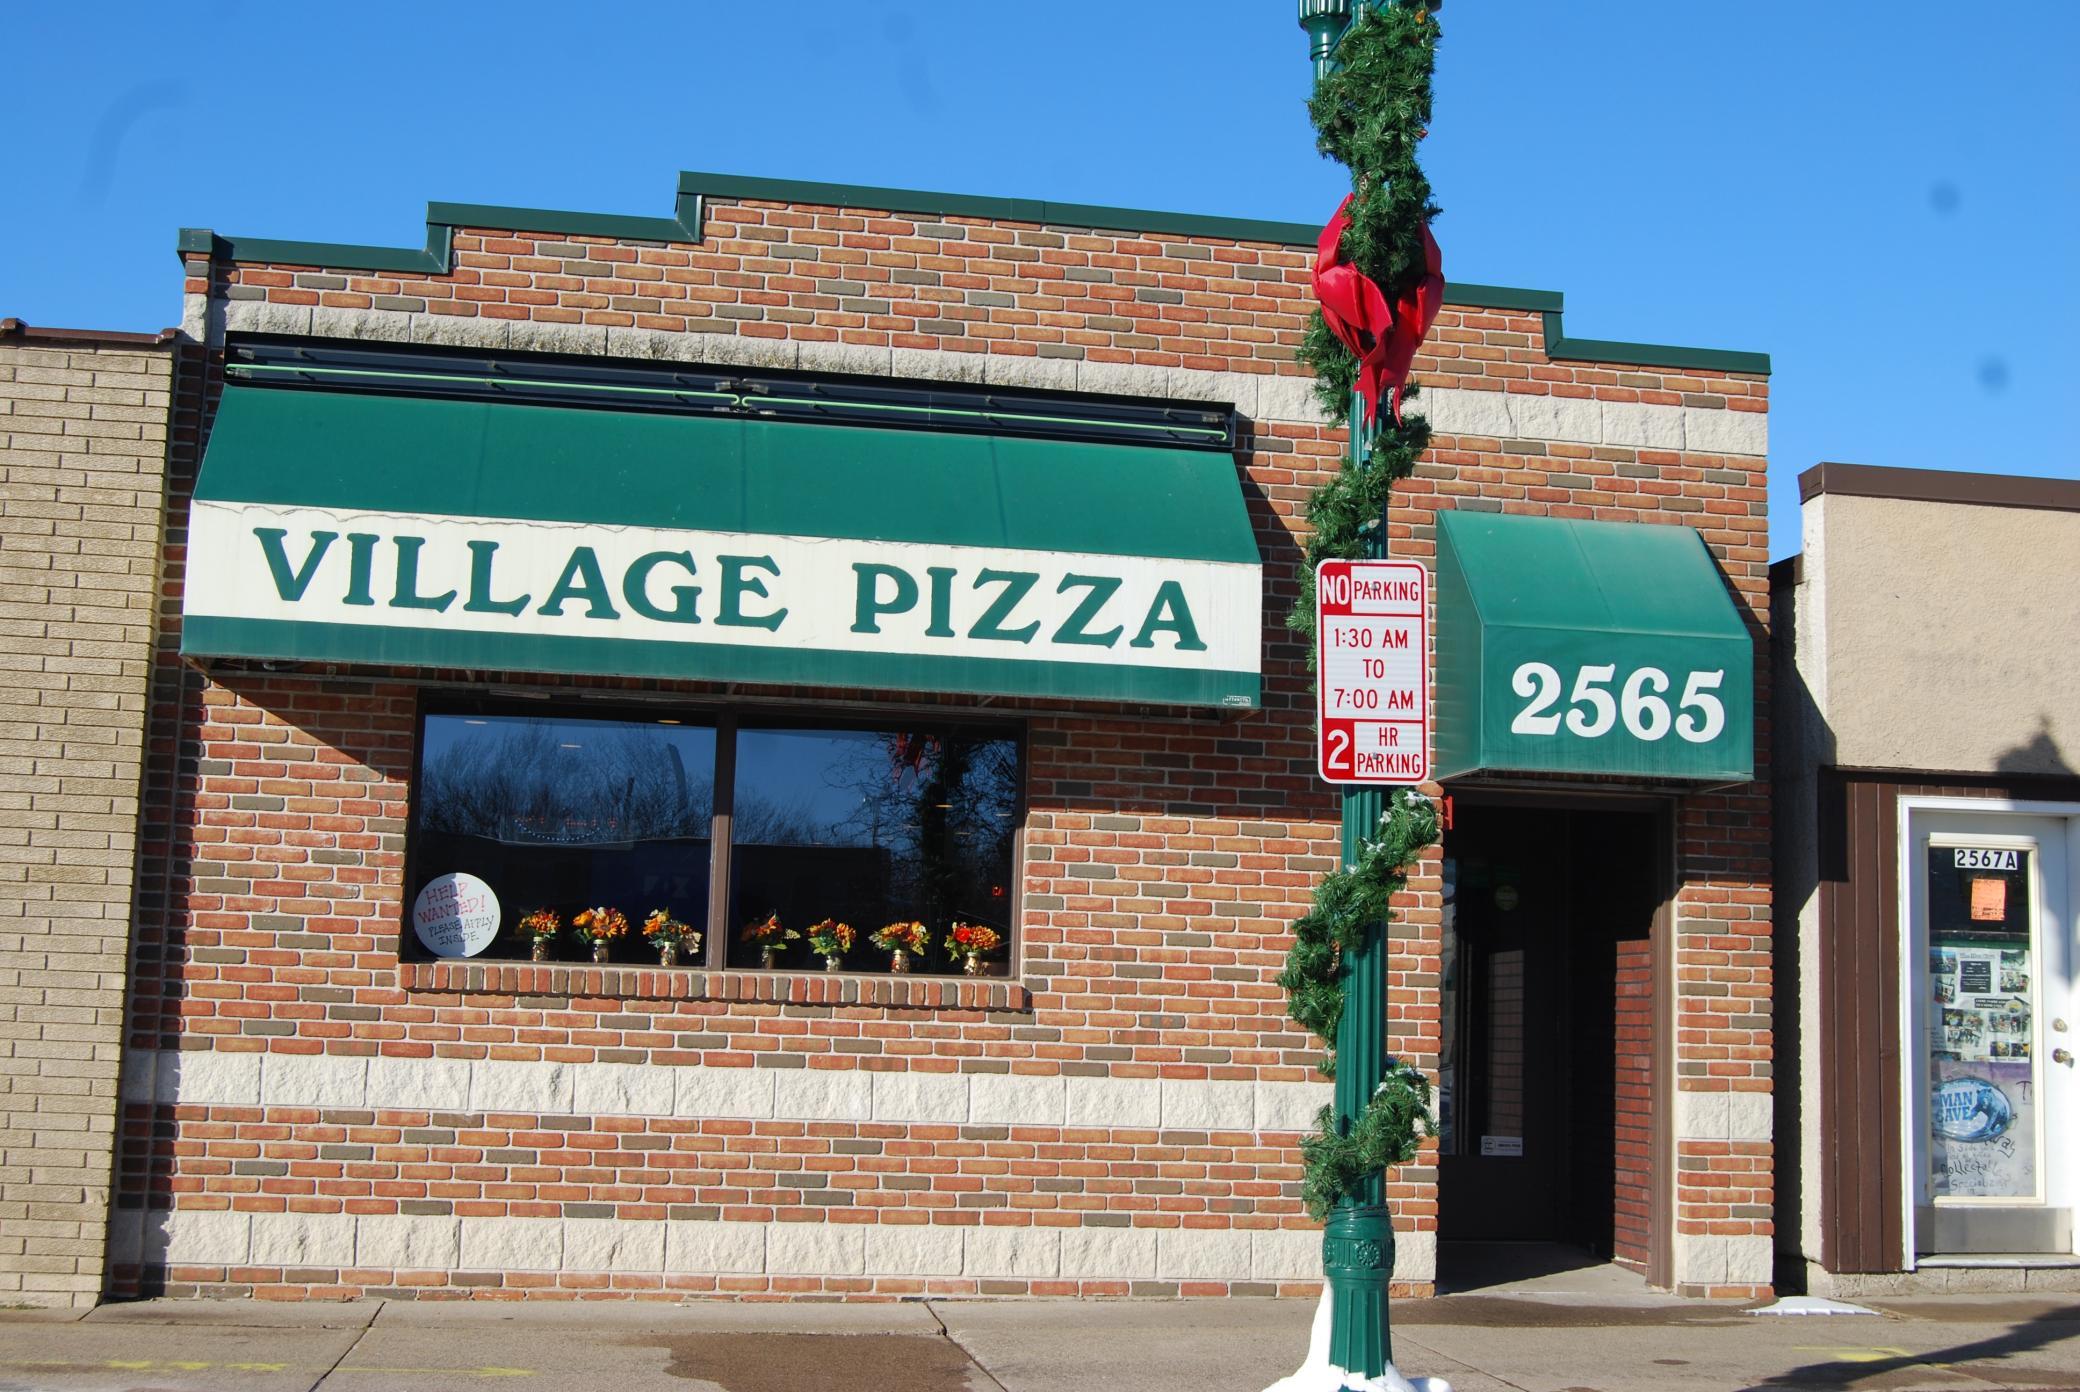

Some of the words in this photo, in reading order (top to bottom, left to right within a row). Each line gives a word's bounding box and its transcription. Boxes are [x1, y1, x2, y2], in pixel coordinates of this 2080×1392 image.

[252, 527, 789, 632] VILLAGE
[850, 561, 1208, 651] PIZZA
[1321, 574, 1350, 605] NO
[1354, 580, 1419, 602] PARKING
[1334, 628, 1373, 648] 1:30
[1382, 629, 1408, 649] AM
[1362, 659, 1385, 679] TO
[1334, 688, 1378, 709] 7:00
[1388, 690, 1414, 710] AM
[1510, 661, 1726, 743] 2565
[1327, 729, 1350, 770] 2
[1378, 727, 1398, 747] HR
[1357, 753, 1421, 774] PARKING
[1956, 850, 2016, 868] 2567A
[425, 882, 468, 905] HELP
[418, 895, 485, 923] WANTED!
[428, 920, 463, 938] PLEASE
[439, 931, 480, 945] INSIDE
[1940, 1091, 1973, 1107] MAN
